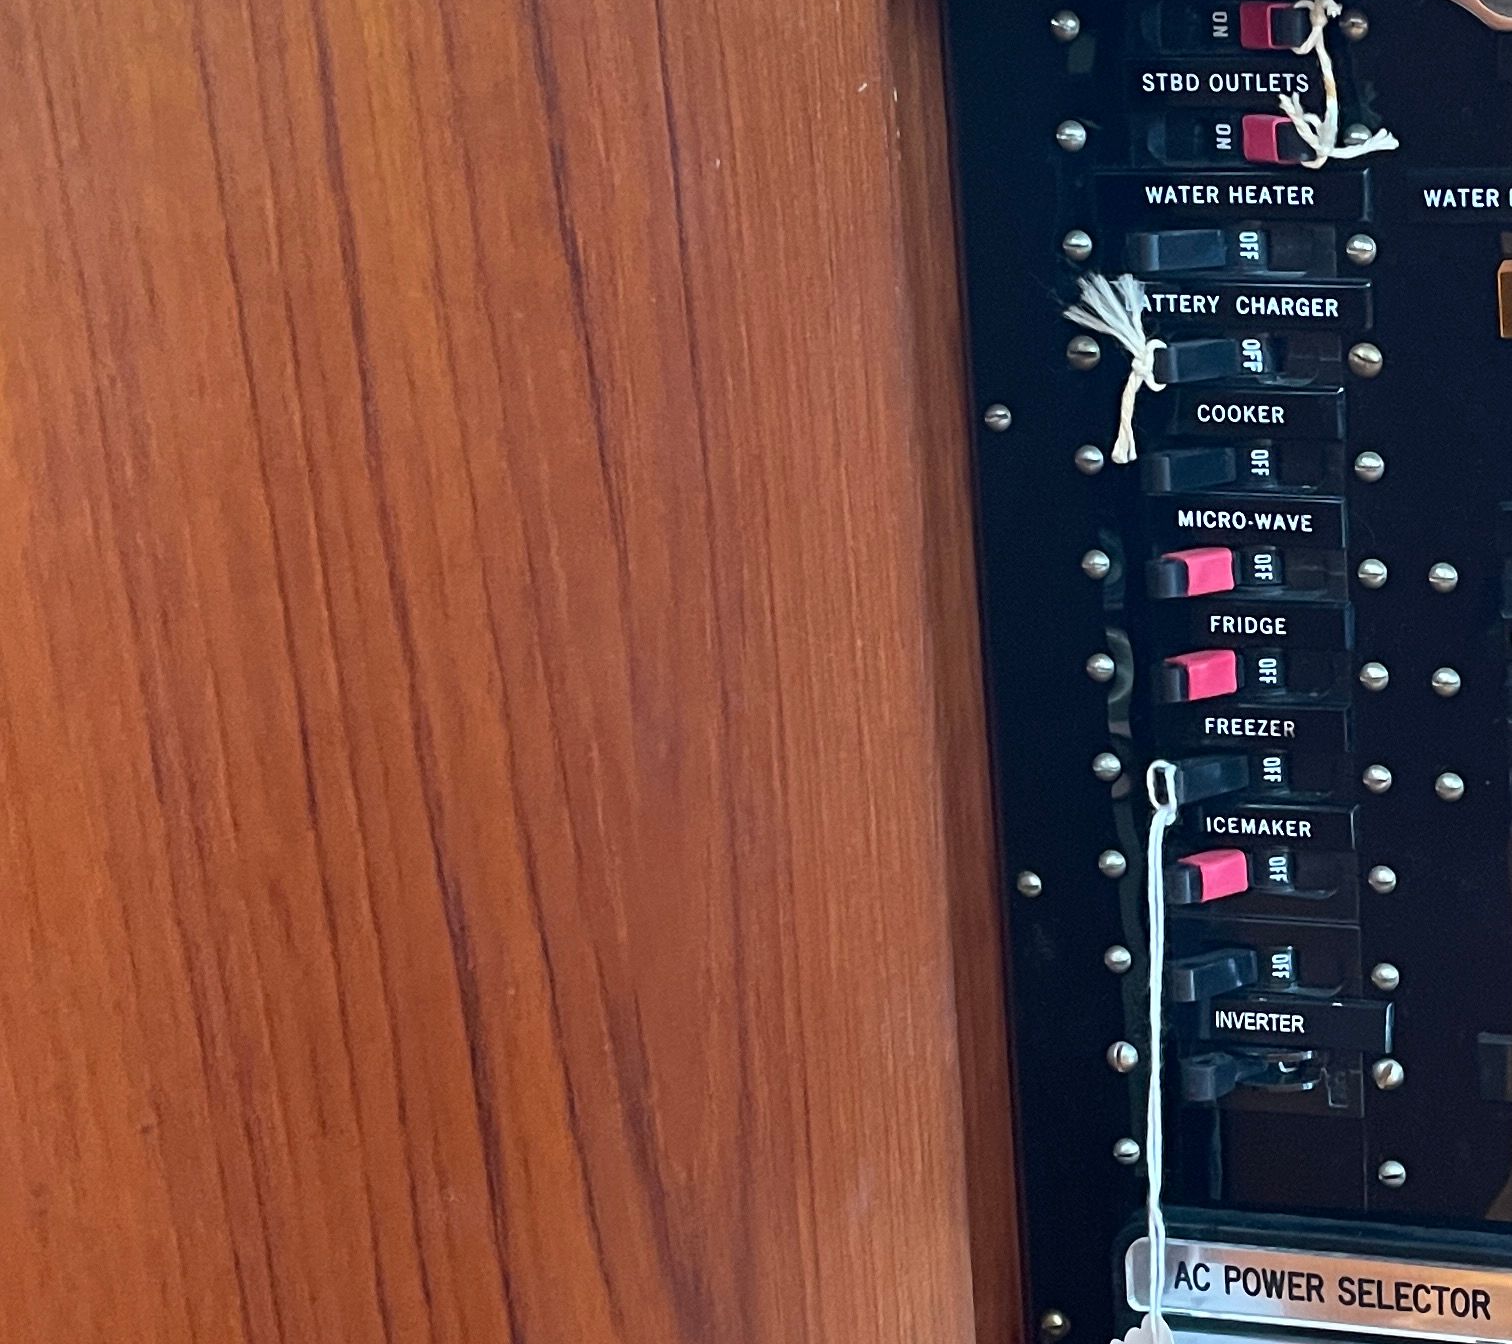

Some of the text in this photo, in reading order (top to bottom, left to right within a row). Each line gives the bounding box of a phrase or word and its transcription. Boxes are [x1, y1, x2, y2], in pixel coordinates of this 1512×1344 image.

[1212, 11, 1229, 37] ON
[1142, 73, 1309, 93] STBD OUTLETS
[1215, 123, 1232, 150] ON
[1145, 186, 1315, 205] WATER HEATER
[1424, 188, 1500, 209] WATER
[1239, 231, 1259, 260] OFF
[1139, 294, 1339, 317] ATTERY CHARGER
[1242, 339, 1263, 373] OFF
[1197, 405, 1285, 424] COOKER
[1250, 449, 1270, 476] OFF
[1178, 510, 1313, 532] MICRO-WAVE
[1254, 553, 1273, 581] OFF
[1210, 615, 1287, 635] FRIDGE
[1259, 658, 1277, 684] OFF
[1205, 717, 1295, 738] FREEZER
[1263, 756, 1282, 783] OFF
[1206, 816, 1311, 838] ICEMAKER
[1268, 856, 1289, 883] OFF
[1271, 954, 1291, 979] OFF
[1215, 1010, 1305, 1033] INVERTER
[1174, 1262, 1492, 1320] AC POWER SELECTOR
